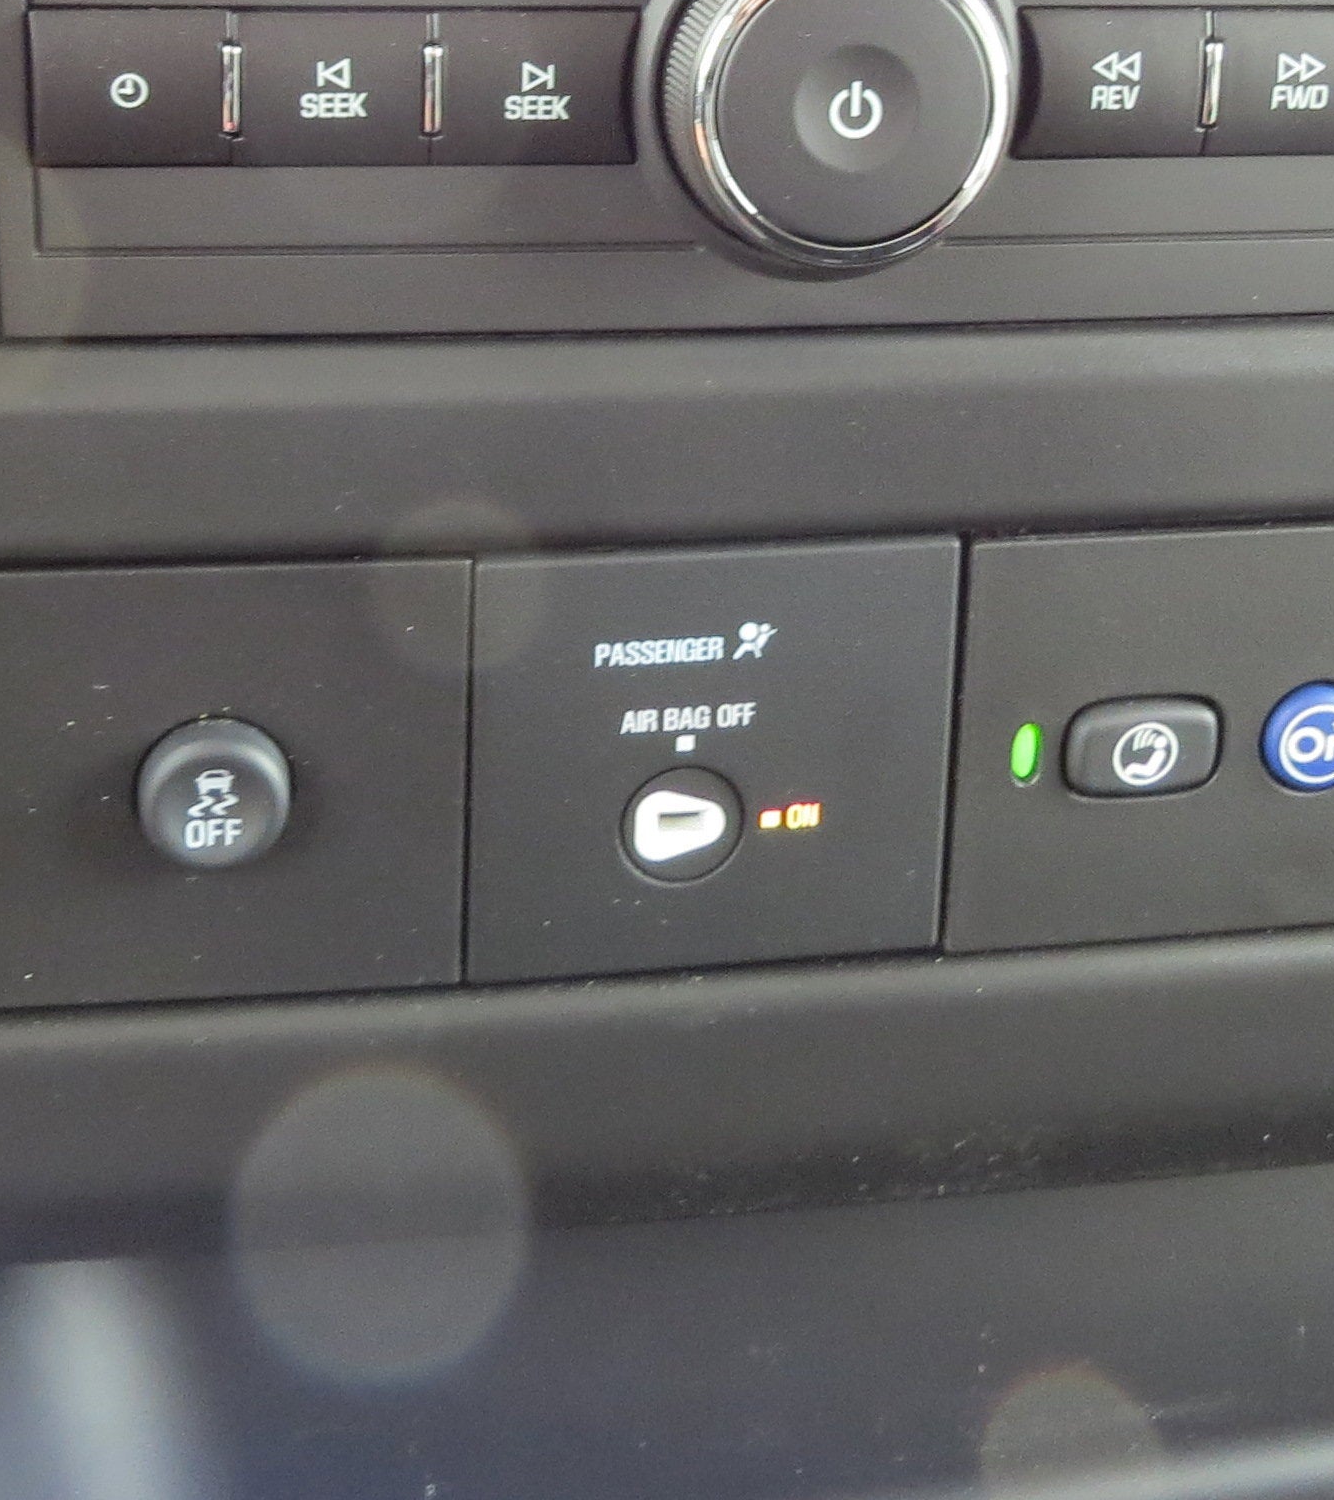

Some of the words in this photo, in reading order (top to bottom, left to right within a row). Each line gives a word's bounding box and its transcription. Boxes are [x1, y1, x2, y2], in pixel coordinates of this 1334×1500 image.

[300, 92, 367, 119] SEEK
[504, 94, 571, 121] SEEK
[1090, 85, 1141, 111] REV
[1270, 84, 1330, 111] FWD
[594, 636, 725, 668] PASSENGER
[620, 709, 659, 735] AIR
[662, 705, 711, 732] BAG
[716, 702, 757, 728] OFF
[785, 802, 821, 829] ON
[184, 818, 244, 850] OFF
